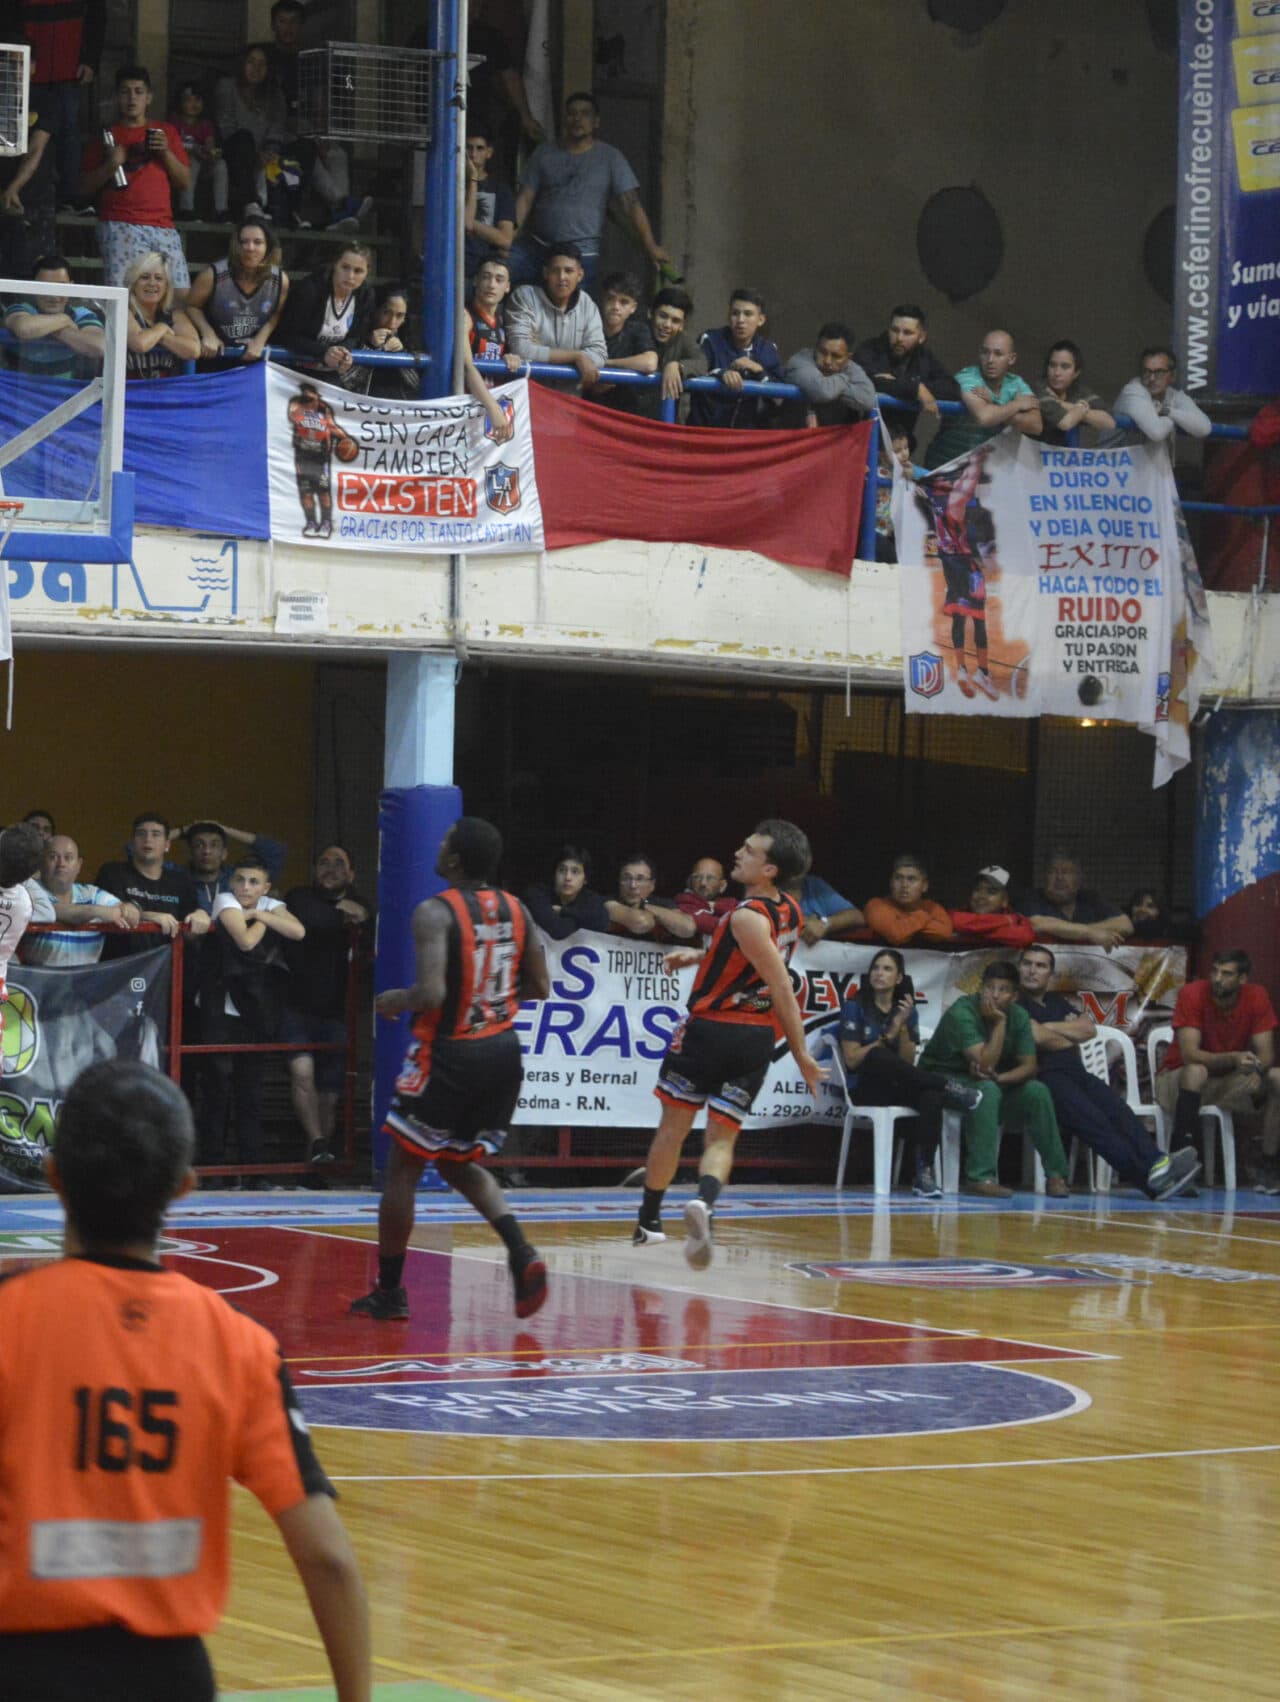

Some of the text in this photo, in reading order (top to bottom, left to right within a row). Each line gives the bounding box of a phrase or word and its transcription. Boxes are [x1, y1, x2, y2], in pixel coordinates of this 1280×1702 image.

[1231, 260, 1280, 287] Sum
[1228, 305, 1242, 328] y
[361, 421, 468, 447] SIN CAPA
[360, 447, 469, 475] TAMBIEN
[1040, 450, 1133, 468] TRABAJA
[1049, 471, 1129, 488] DURO Y
[342, 475, 473, 515] EXISTEN
[1029, 494, 1153, 514] EN SILENCIO
[340, 517, 532, 543] GRACIAS POR TANTO CAPITAN
[1029, 519, 1041, 537] Y
[1047, 519, 1093, 537] DEJA
[1098, 518, 1135, 538] QUE
[1038, 541, 1159, 572] EXITO
[1039, 575, 1164, 596] HAGA TODO EL
[1057, 597, 1142, 623] RUIDO
[1064, 643, 1084, 656] TU
[1063, 660, 1141, 674] Y ENTREGA
[624, 977, 680, 1001] Y TELAS
[565, 1071, 575, 1087] y
[580, 1069, 637, 1085] Bernal
[577, 1096, 611, 1111] R.N.
[370, 1385, 698, 1408] BANCO
[432, 1389, 956, 1418] PATAGONIA
[74, 1386, 179, 1474] 165
